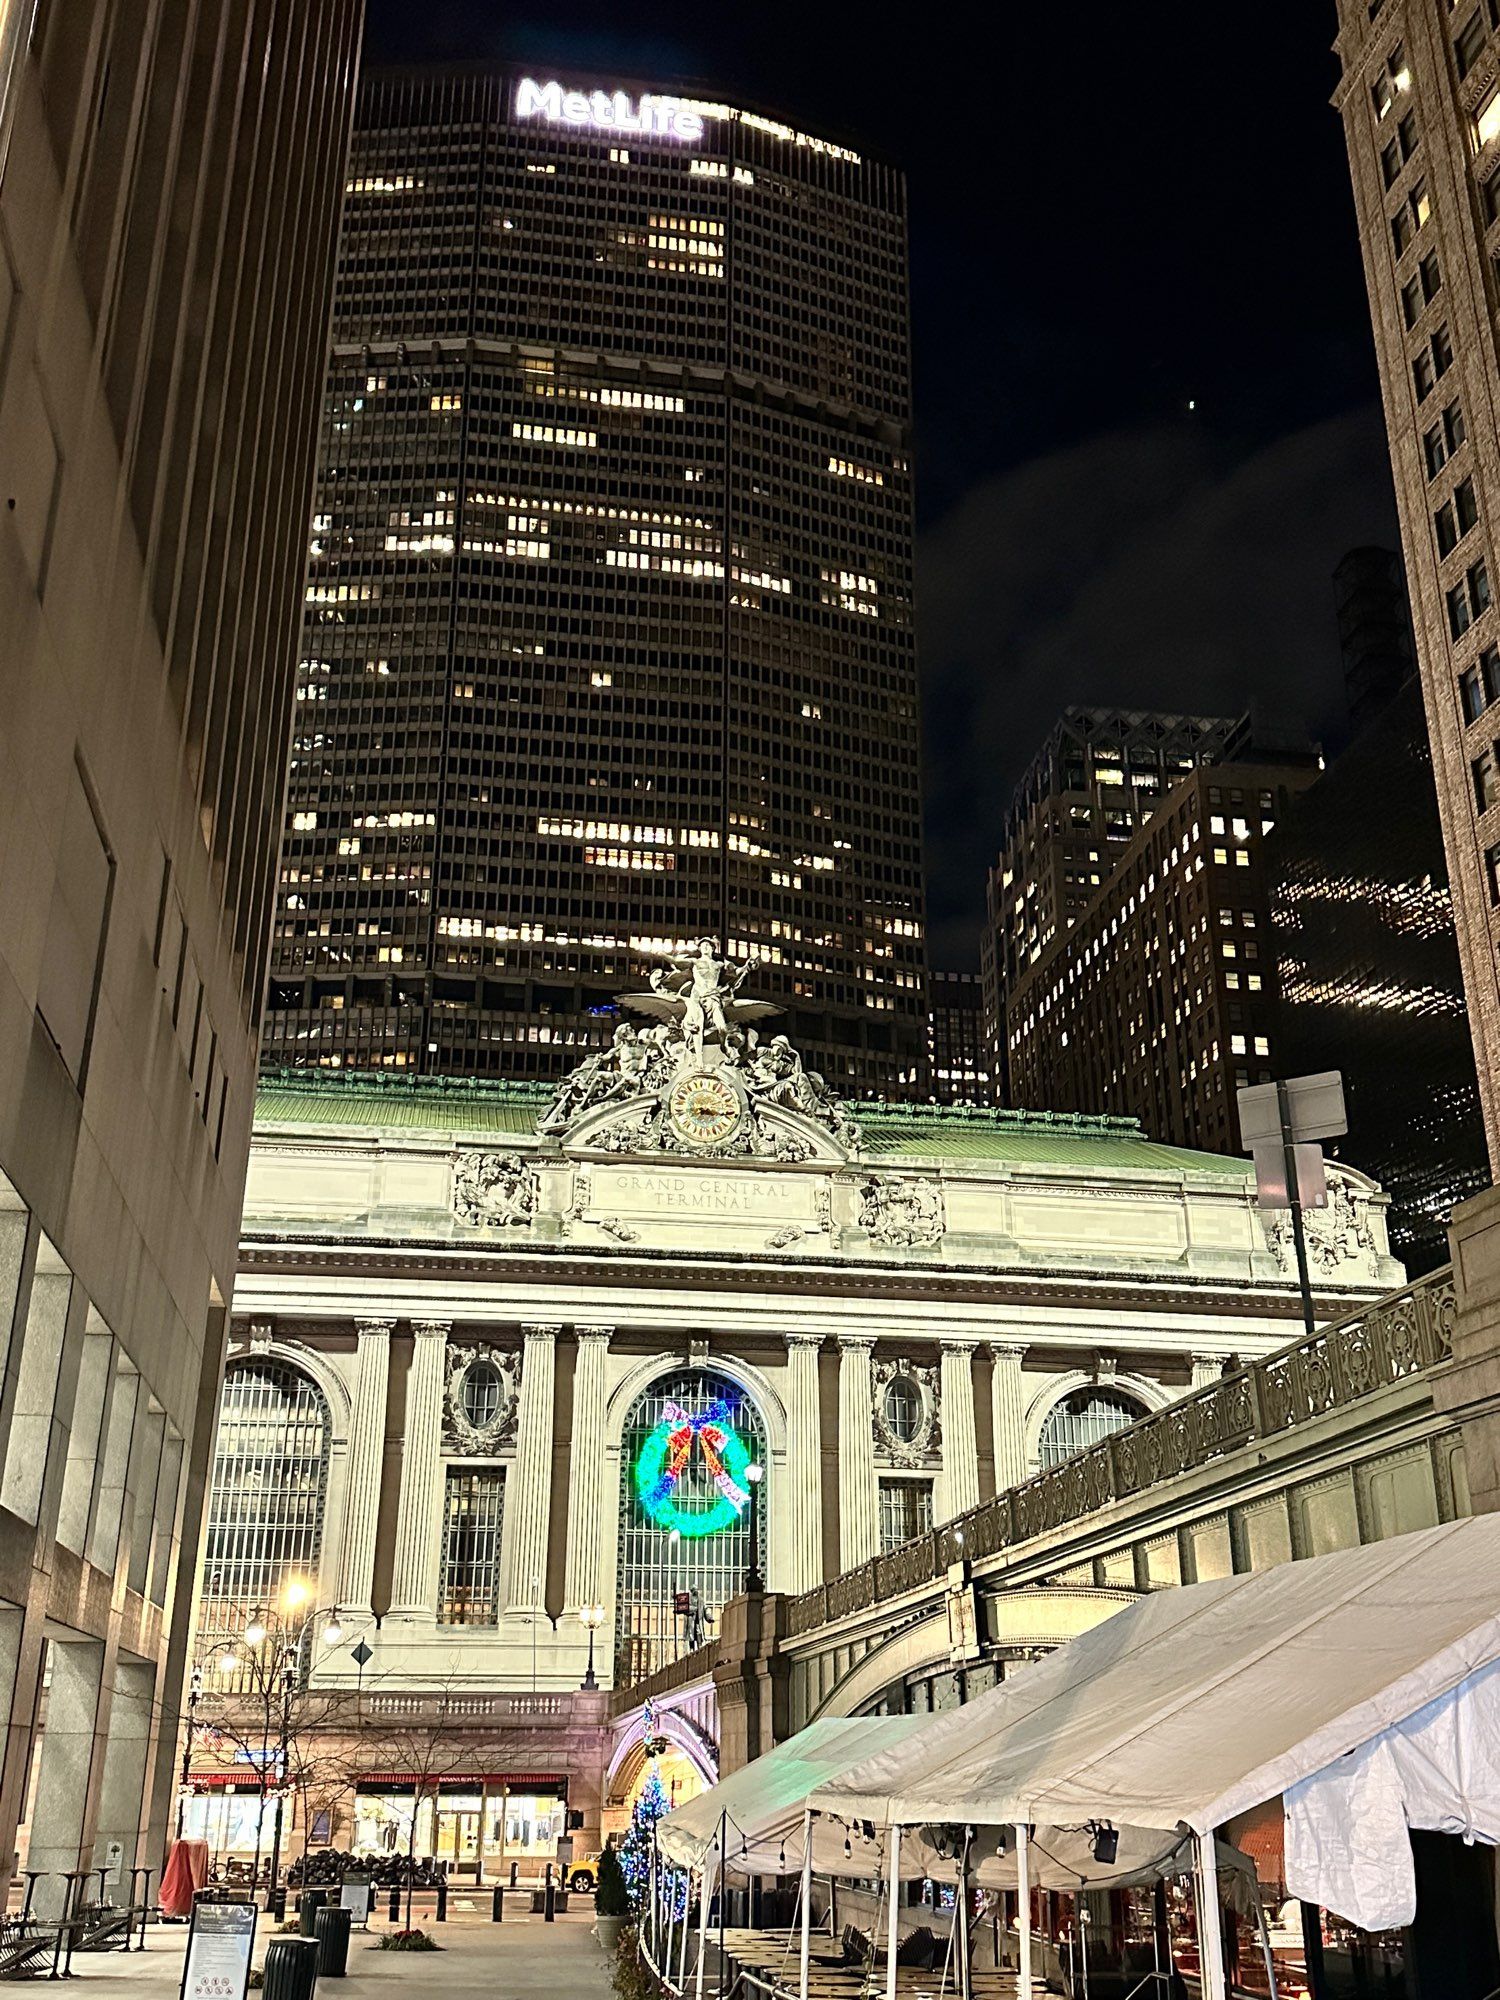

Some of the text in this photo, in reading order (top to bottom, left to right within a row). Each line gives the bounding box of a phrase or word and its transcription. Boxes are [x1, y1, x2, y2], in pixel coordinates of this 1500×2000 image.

[516, 78, 703, 138] MetLife
[616, 1176, 789, 1197] GRAND CENTRAL
[654, 1193, 752, 1209] TERMINAL
